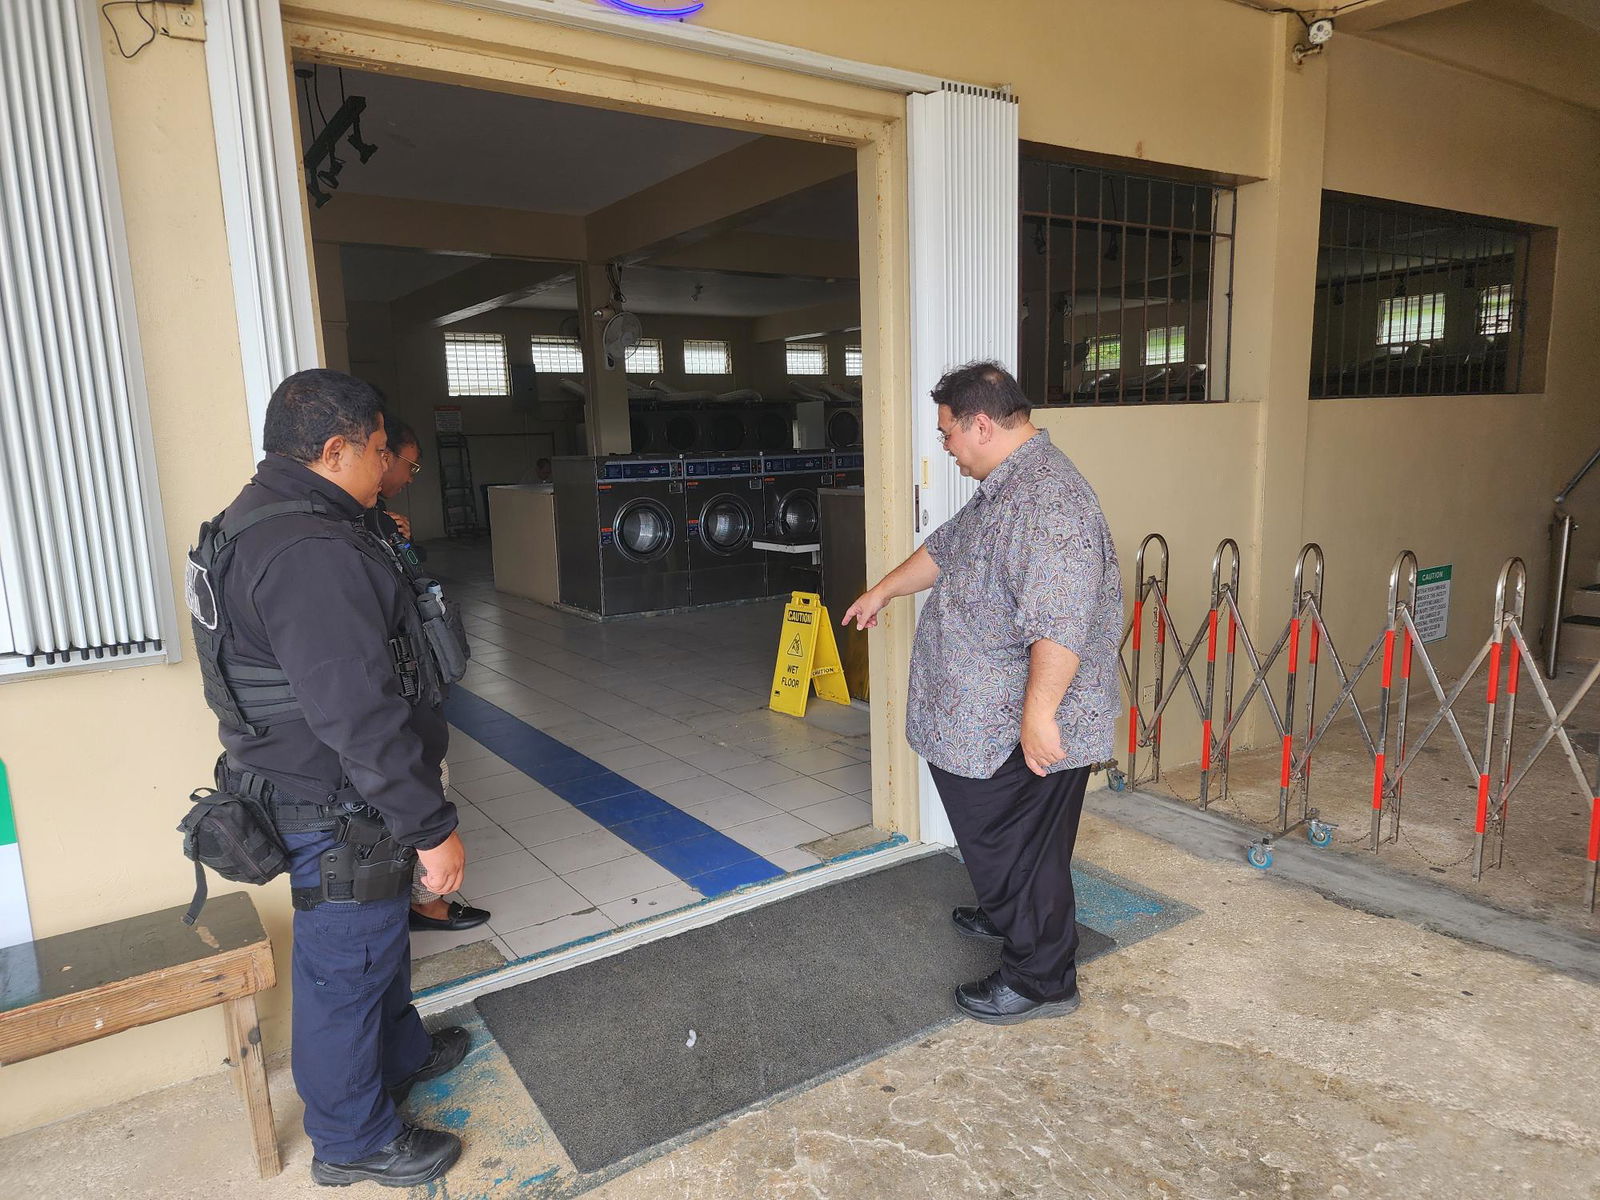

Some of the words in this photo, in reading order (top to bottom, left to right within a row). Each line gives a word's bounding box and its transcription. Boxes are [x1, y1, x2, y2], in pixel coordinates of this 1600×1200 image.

[1422, 571, 1443, 581] CAUTION
[788, 610, 813, 623] CAUTION
[787, 664, 798, 674] WET
[781, 677, 799, 688] FLOOR
